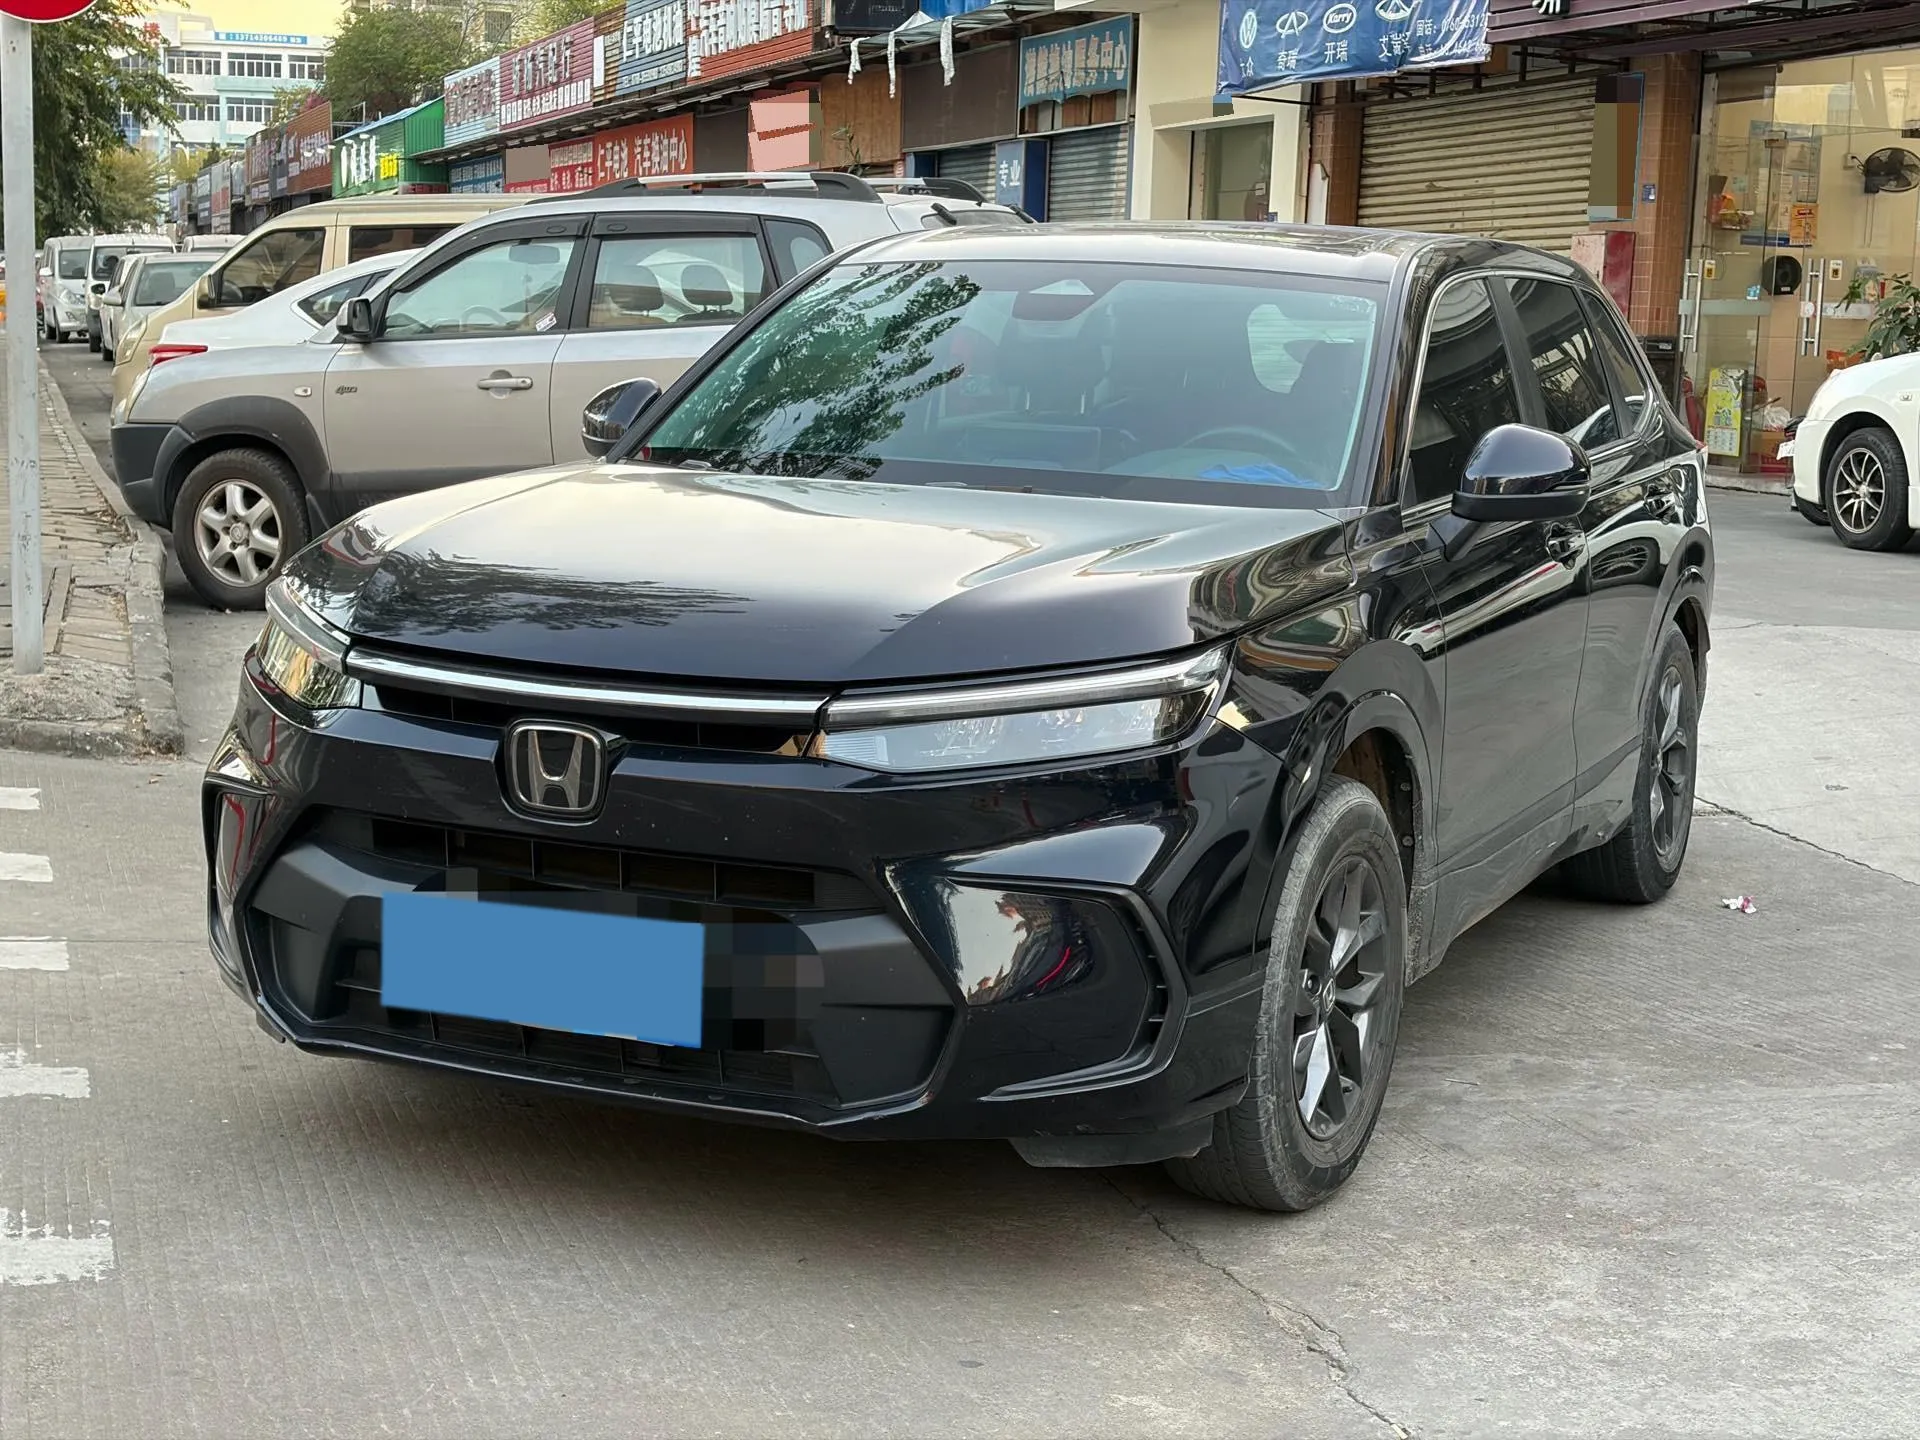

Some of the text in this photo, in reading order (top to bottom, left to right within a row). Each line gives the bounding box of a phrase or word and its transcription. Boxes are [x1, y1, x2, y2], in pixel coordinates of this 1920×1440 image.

[1276, 48, 1299, 72] 奇瑞
[1324, 40, 1348, 64] 开瑞
[634, 127, 688, 177] 汽车换油中心
[998, 159, 1021, 188] 专业
